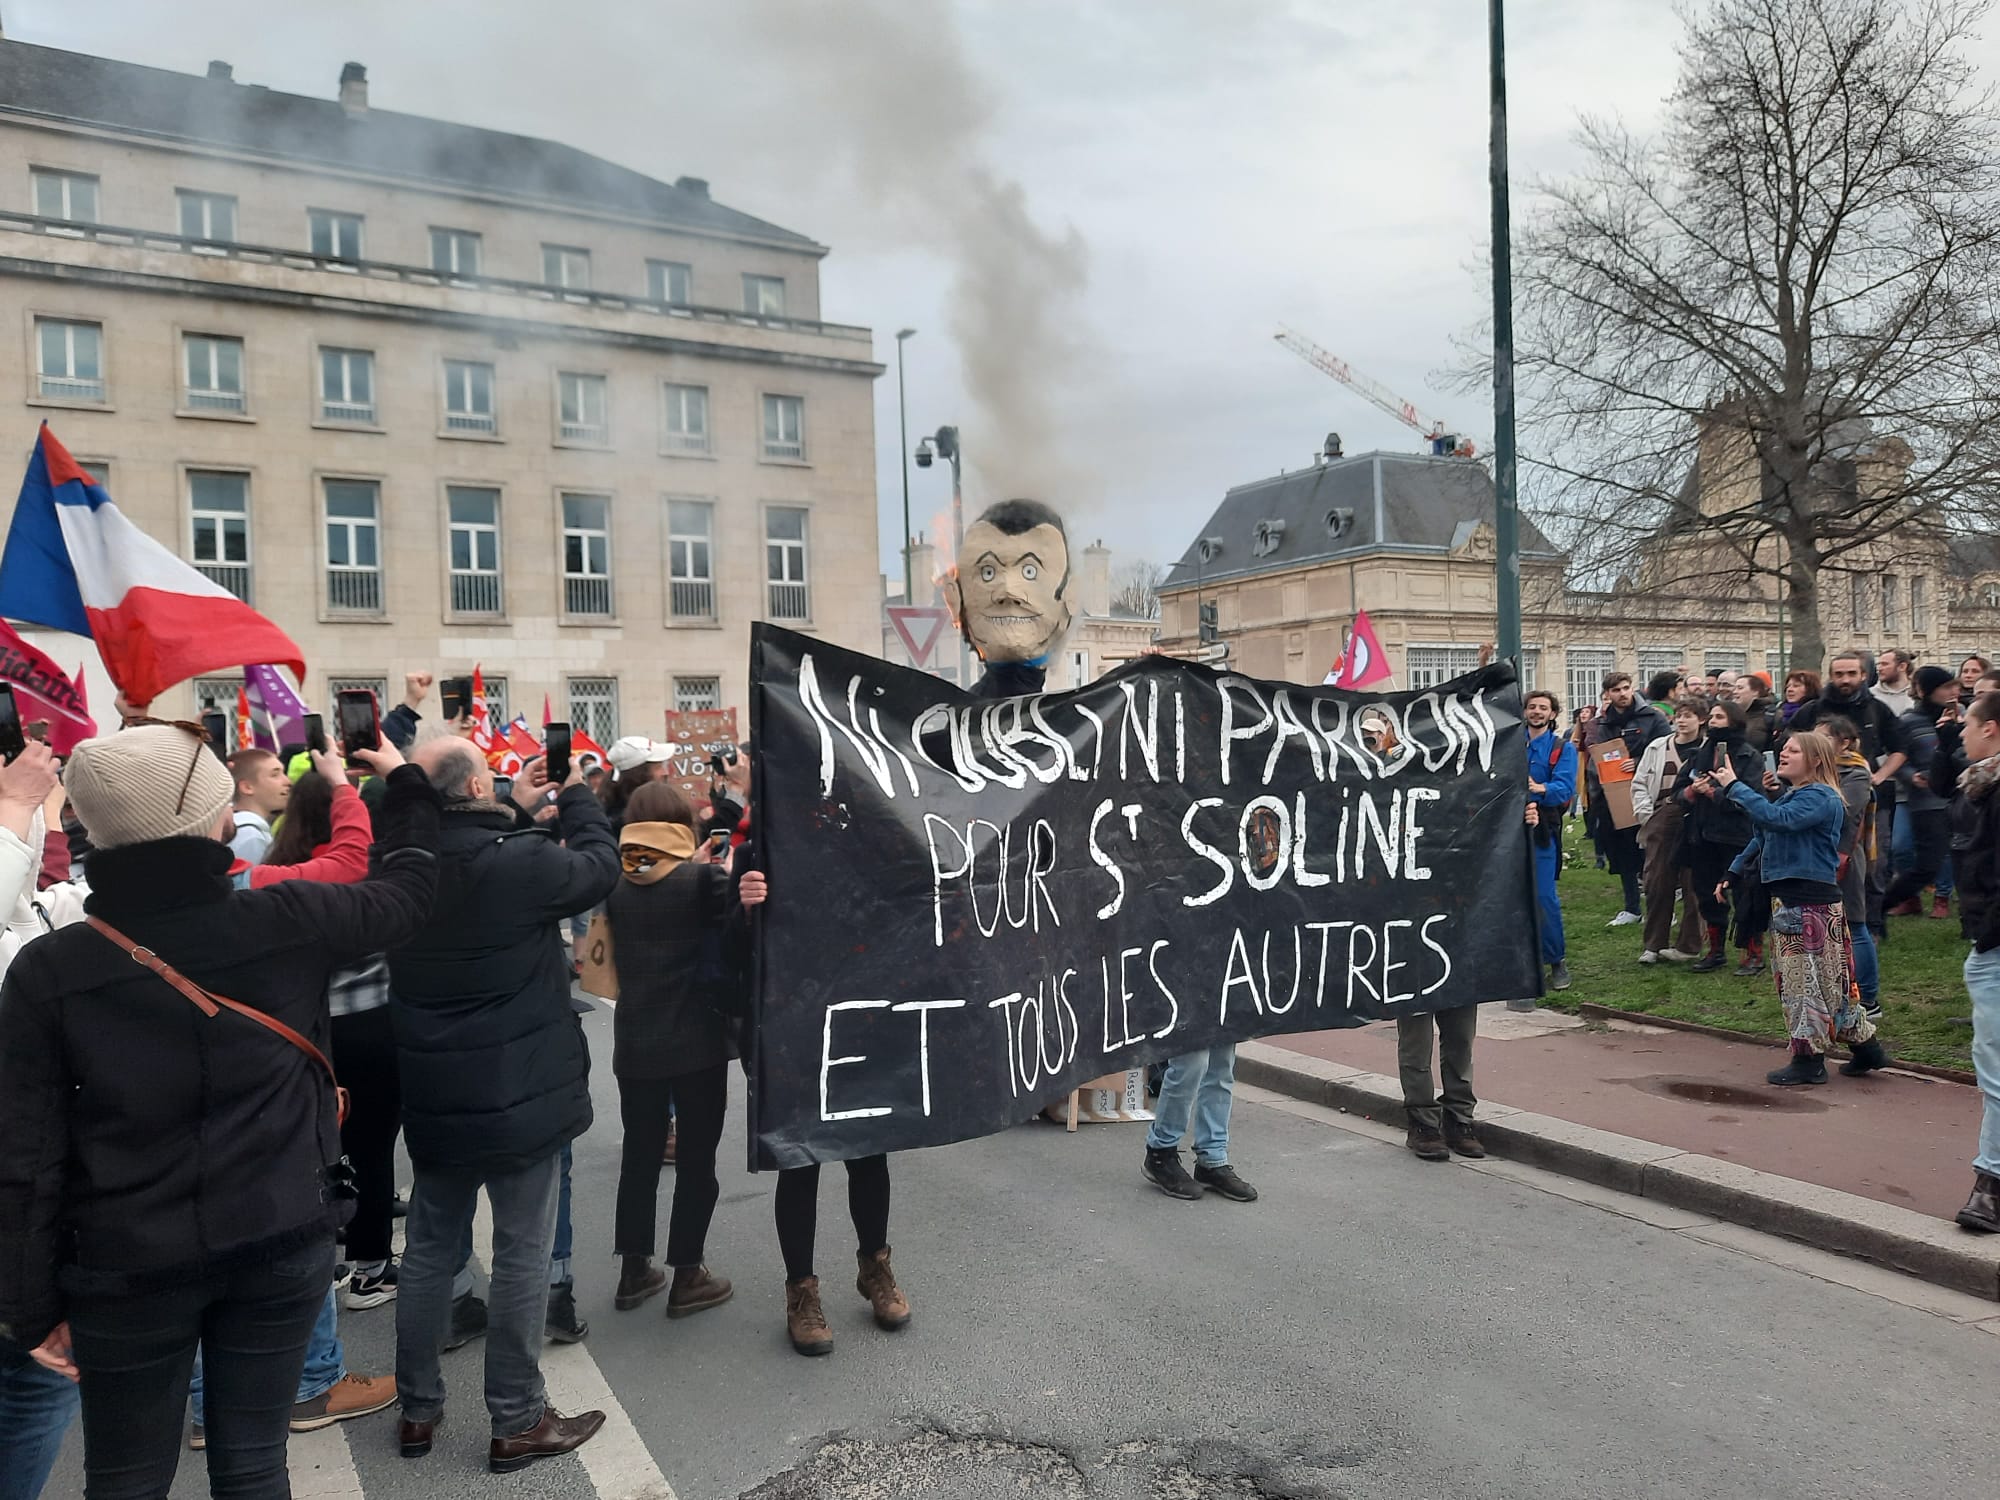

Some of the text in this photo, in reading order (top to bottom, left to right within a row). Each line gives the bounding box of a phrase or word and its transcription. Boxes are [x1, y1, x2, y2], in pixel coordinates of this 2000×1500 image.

[923, 813, 1061, 947] POUR
[819, 914, 1452, 1122] ET TOUS LES AUTRES
